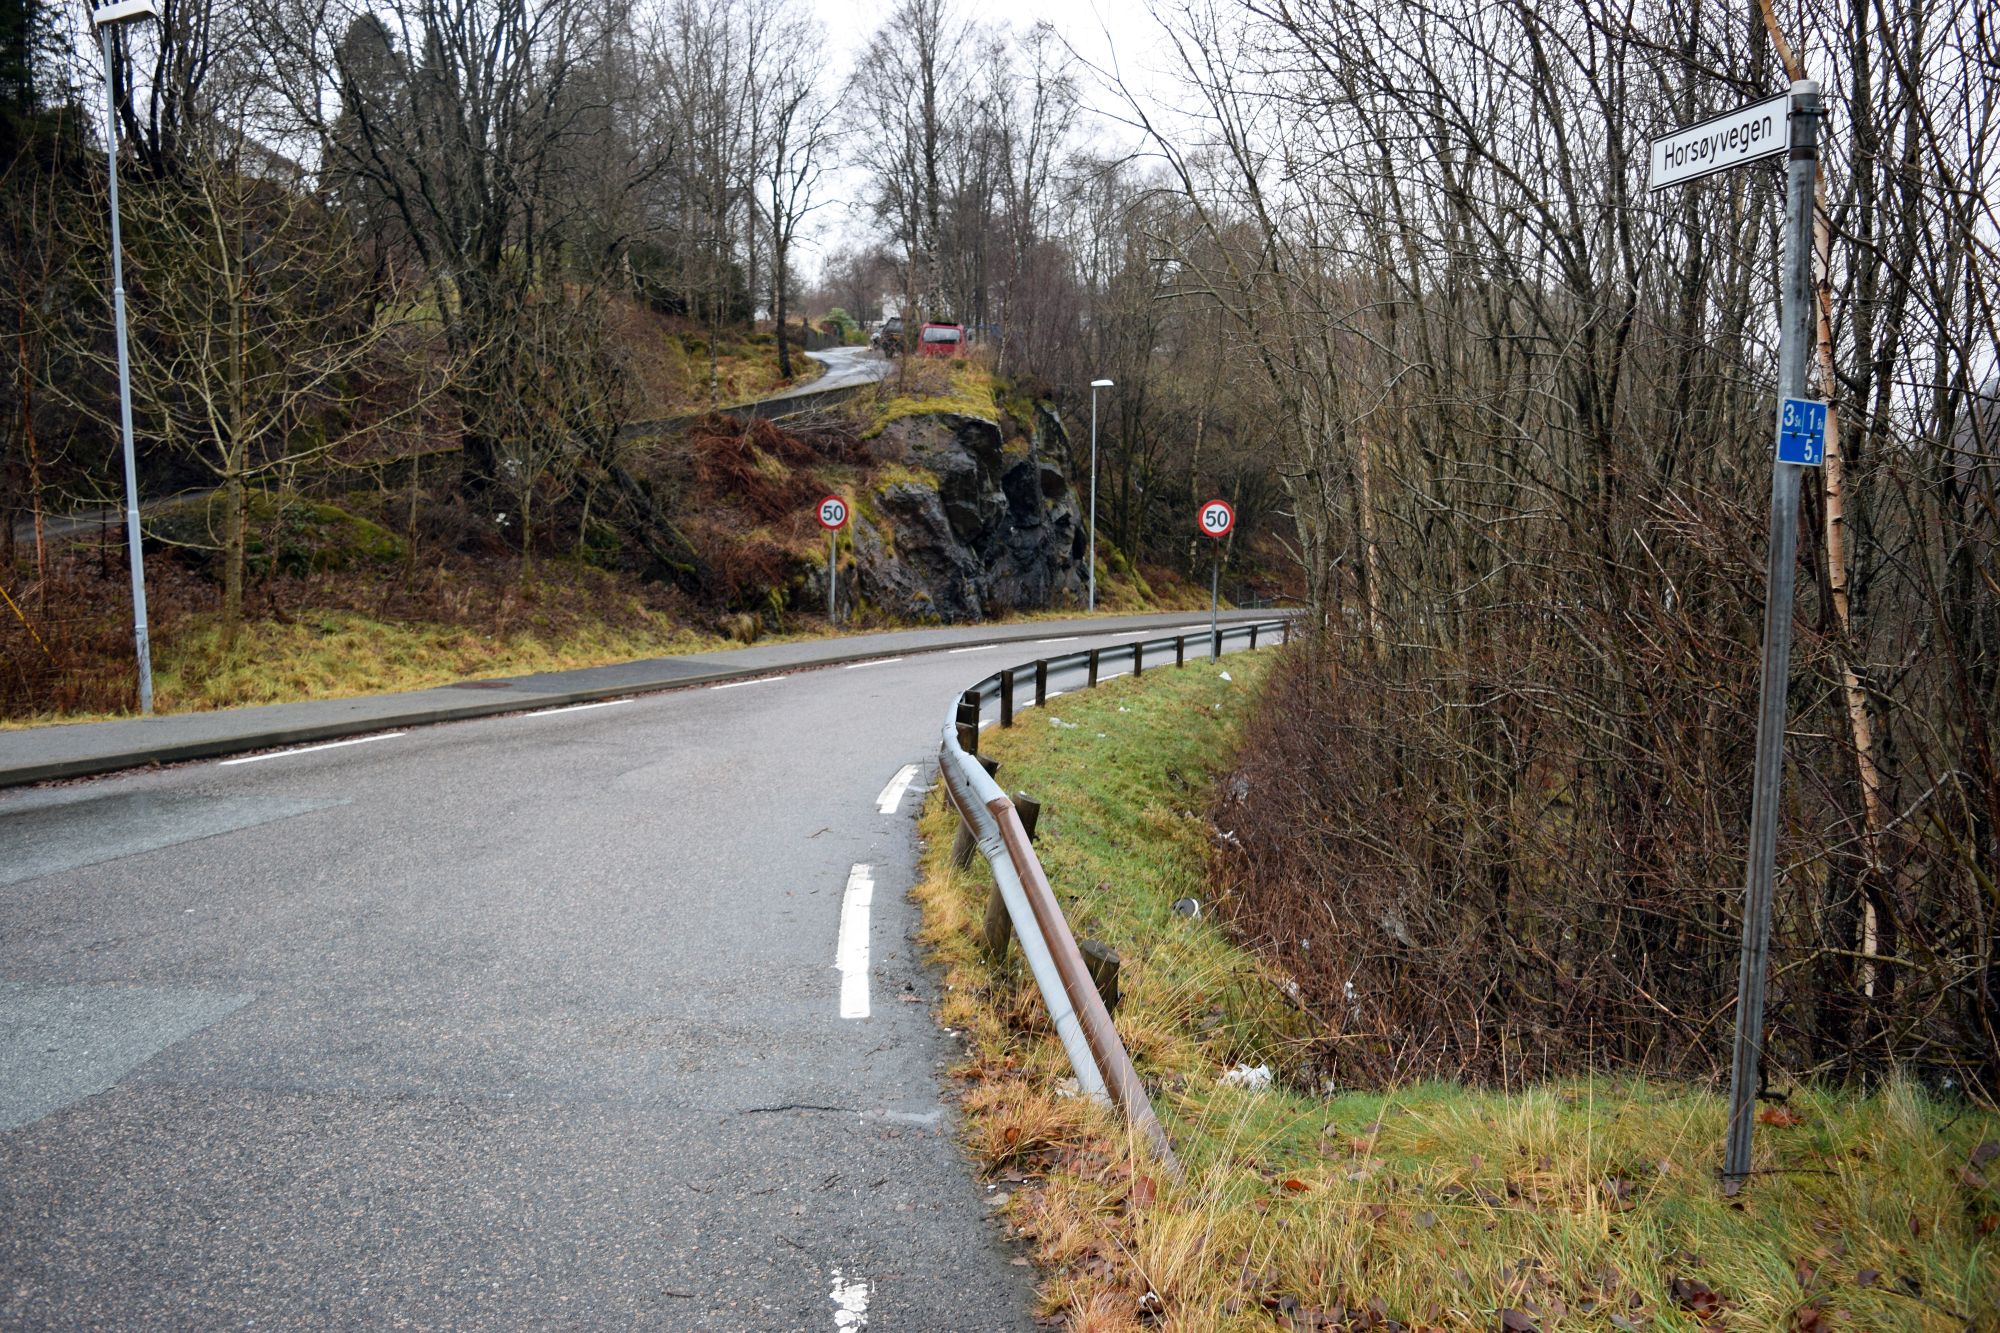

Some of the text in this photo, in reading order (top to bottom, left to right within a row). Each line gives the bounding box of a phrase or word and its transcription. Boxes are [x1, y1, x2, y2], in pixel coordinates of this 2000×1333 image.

[1664, 115, 1772, 170] Horsøyvegen
[1784, 403, 1795, 427] 3
[1809, 407, 1815, 430] 1
[1803, 438, 1813, 461] 5
[823, 505, 844, 521] 50
[1205, 510, 1228, 527] 50
